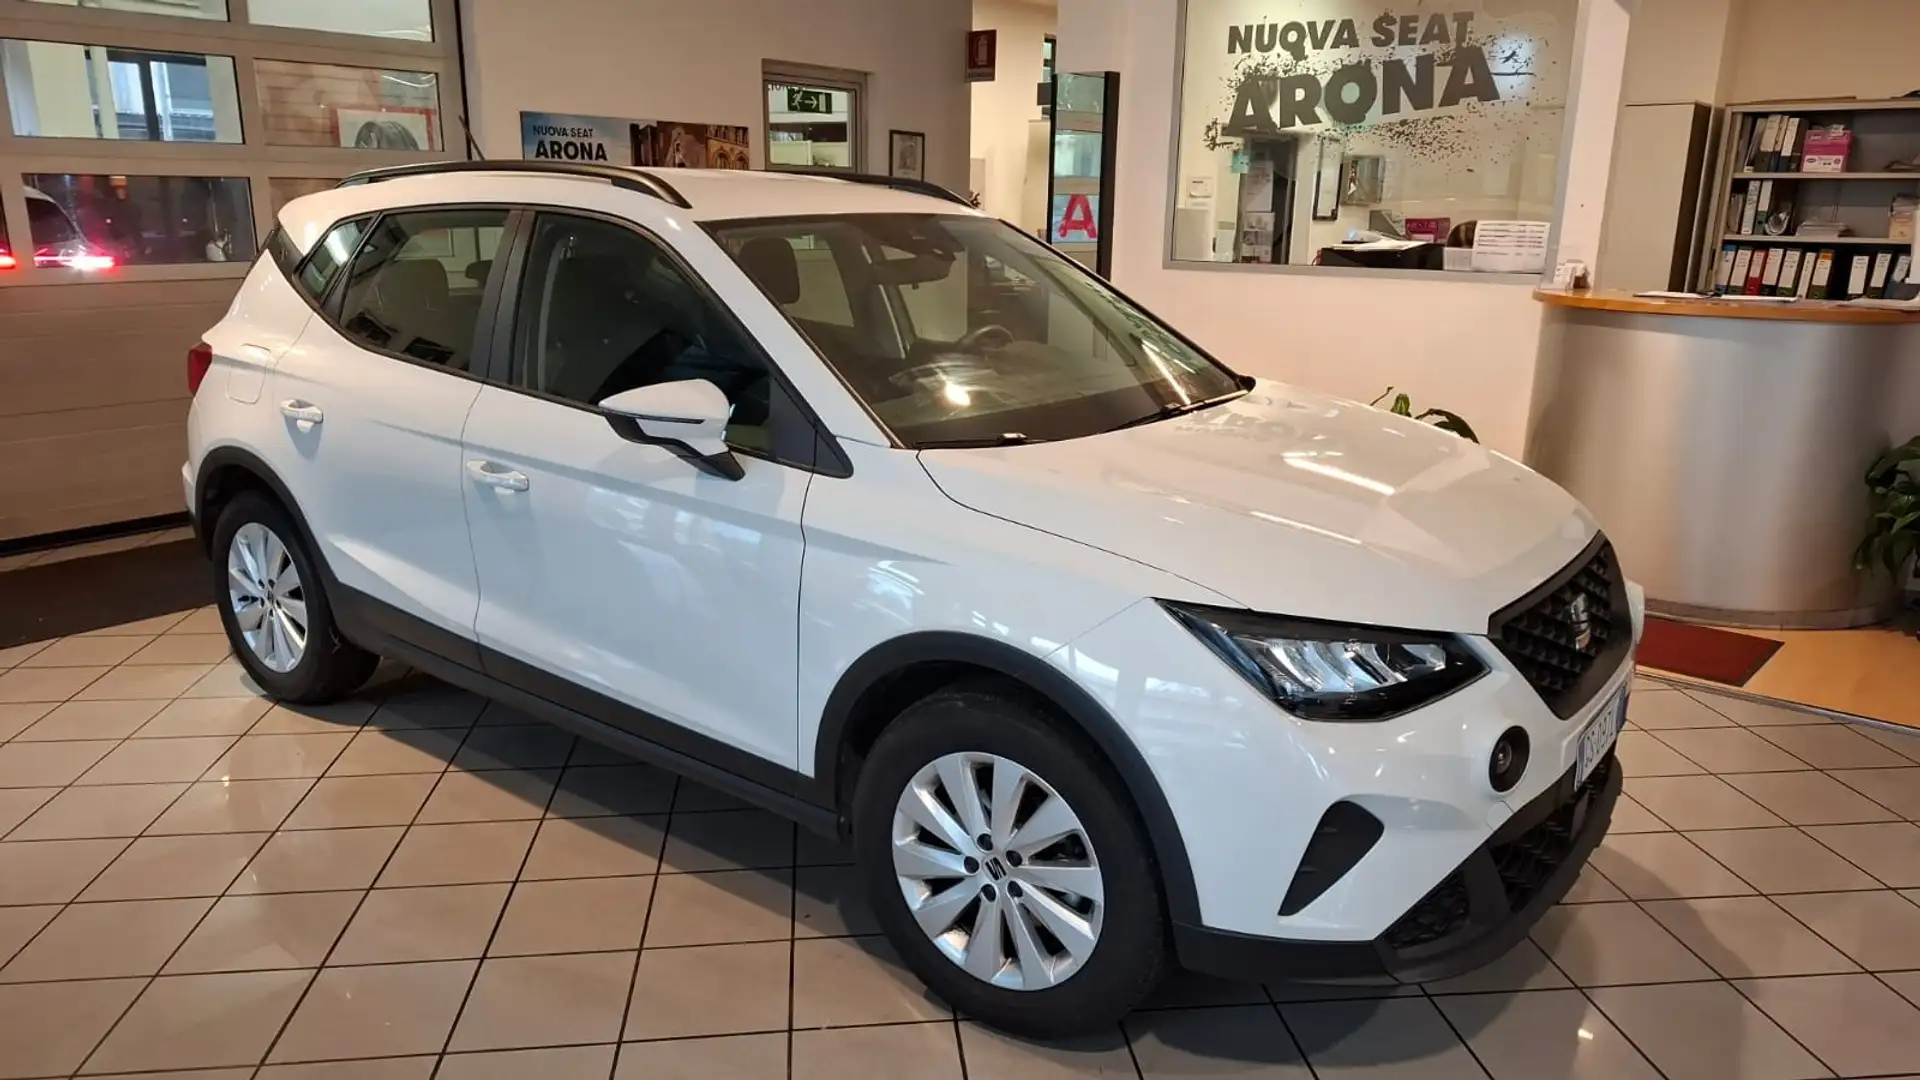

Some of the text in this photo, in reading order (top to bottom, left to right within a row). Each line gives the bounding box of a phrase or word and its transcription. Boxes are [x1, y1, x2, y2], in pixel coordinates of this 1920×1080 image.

[1372, 10, 1474, 48] SEAT
[1221, 46, 1500, 137] ARONA
[533, 125, 594, 138] NUOVA SEAT
[535, 140, 608, 161] ARONA
[1060, 193, 1097, 239] A
